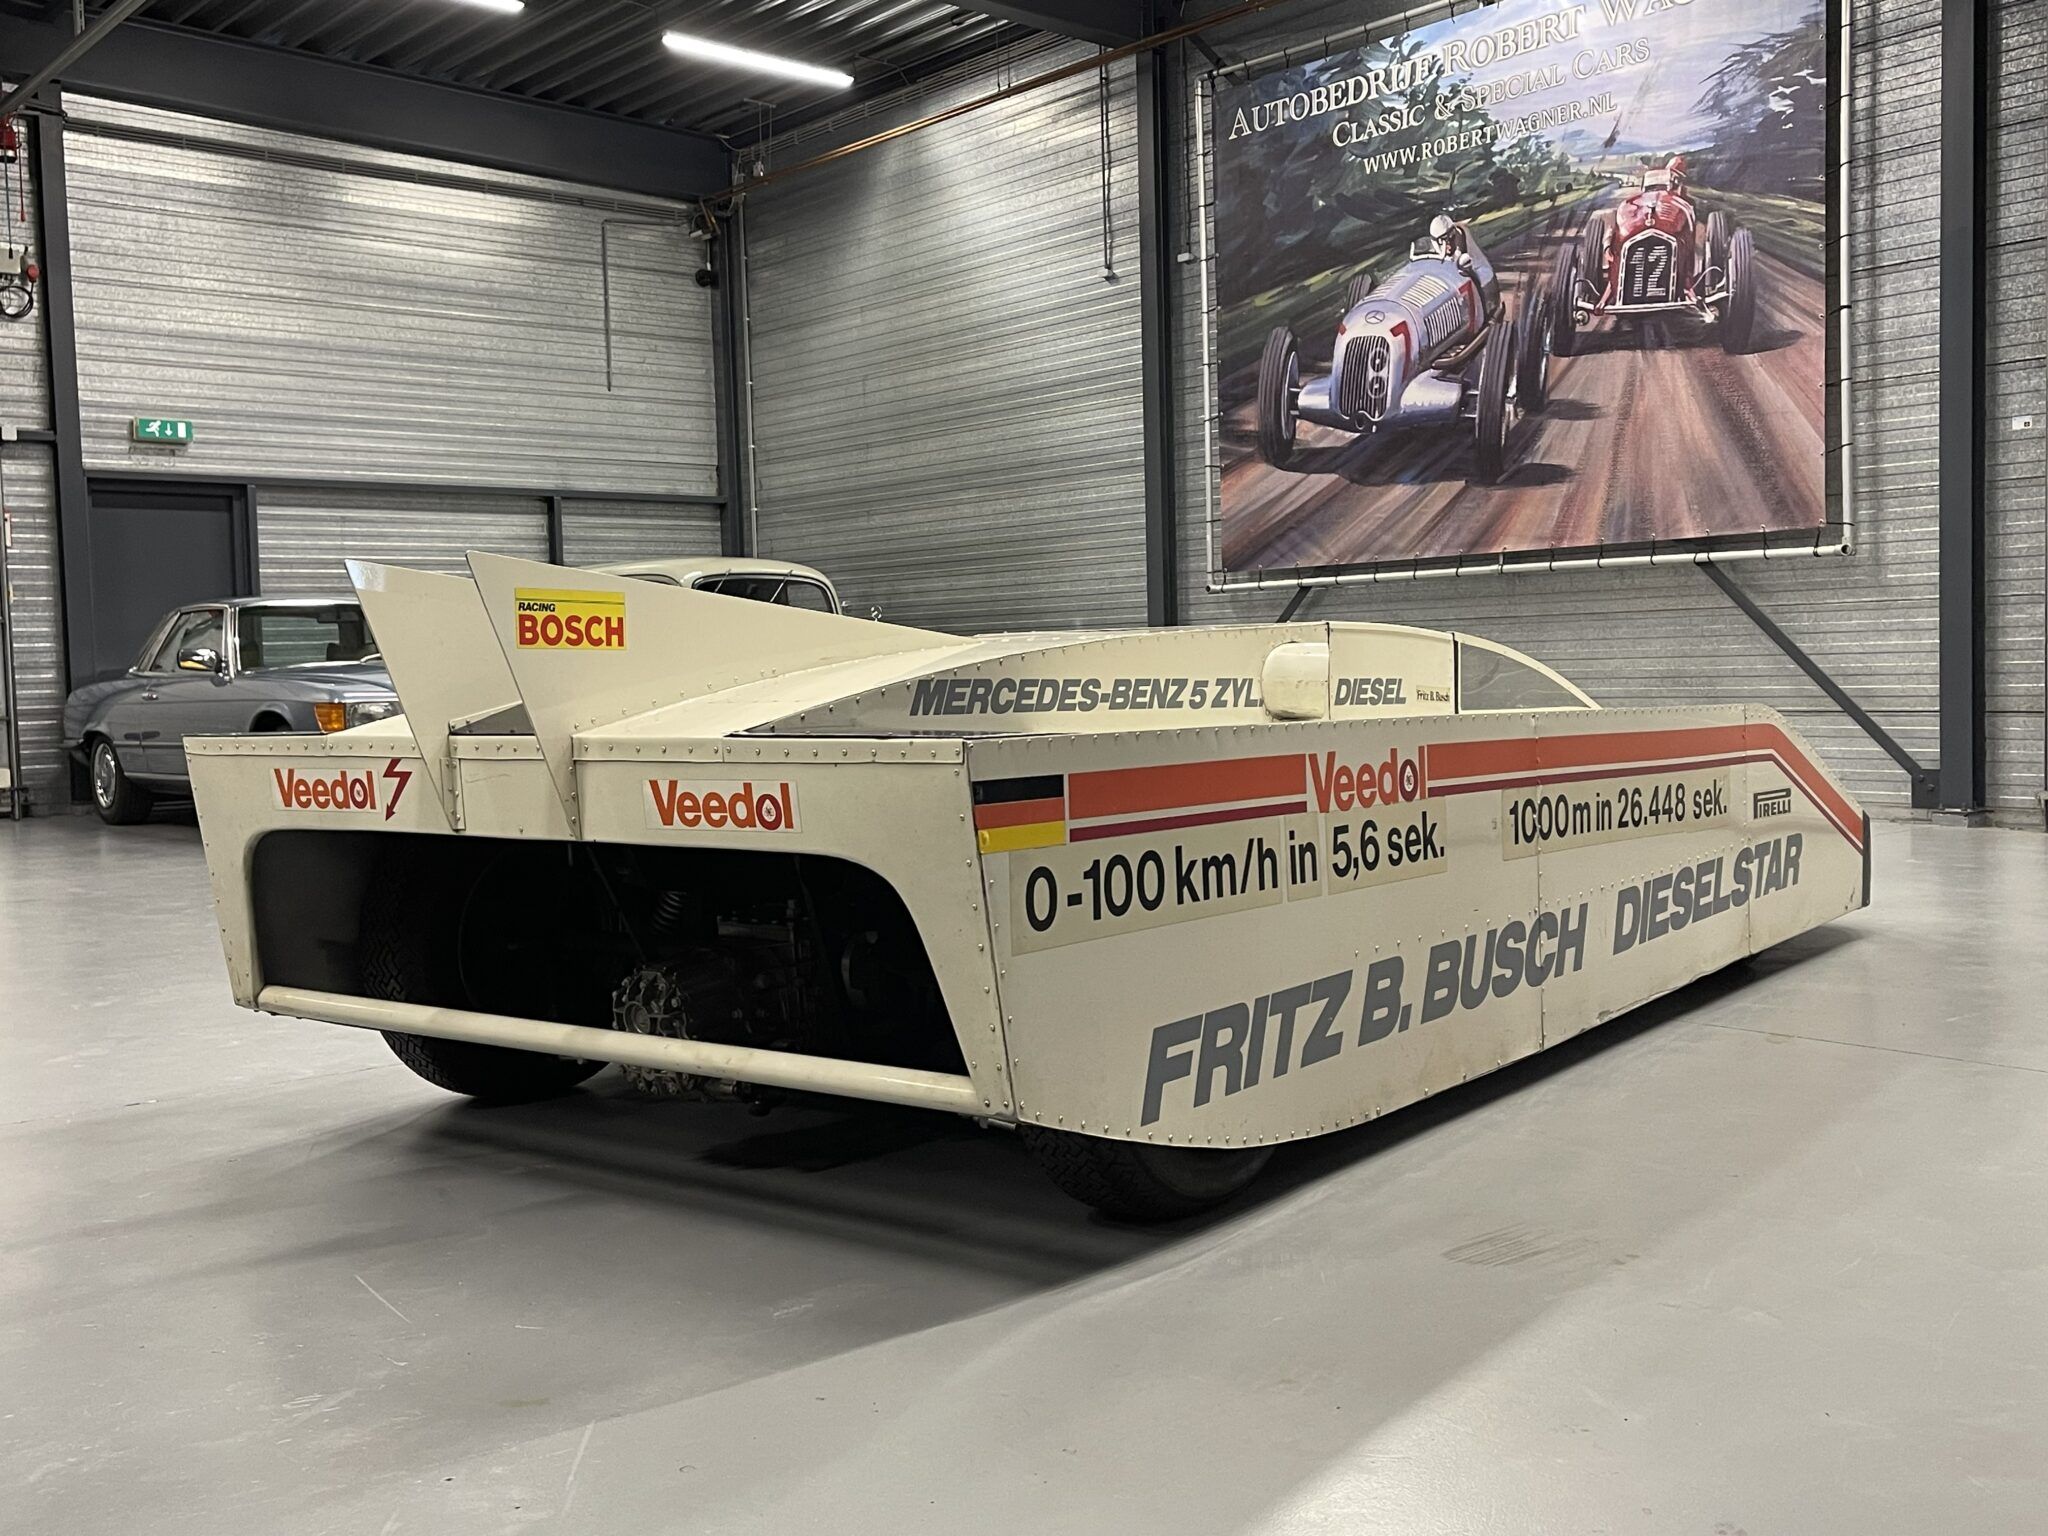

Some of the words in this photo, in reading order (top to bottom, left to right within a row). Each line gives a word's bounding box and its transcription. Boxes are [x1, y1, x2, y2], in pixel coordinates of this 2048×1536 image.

[1228, 54, 1441, 141] AUTOBEDRIJF
[1441, 4, 1587, 78] ROBERT
[1332, 104, 1426, 148] CLASSIC
[1433, 93, 1452, 121] &
[1459, 63, 1566, 113] SPECIAL
[1571, 37, 1650, 80] CARS
[1362, 91, 1618, 175] WWW.ROBERTWAGNER.NL
[518, 602, 556, 612] RACING
[518, 613, 625, 647] BOSCH
[909, 677, 1189, 718] MERCEDES-BENZ
[1188, 679, 1210, 710] 5
[1335, 677, 1407, 706] DIESEL
[273, 767, 378, 812] Veedol
[649, 779, 794, 831] Veedol
[1309, 745, 1427, 813] Veedol
[1596, 792, 1612, 832] in
[1617, 782, 1686, 829] 26.448
[1692, 778, 1728, 820] sek.
[1753, 787, 1792, 820] PIRELLI
[1175, 837, 1278, 907] km/h
[1288, 830, 1318, 892] in
[1331, 819, 1381, 881] 5,6
[1387, 810, 1446, 867] sek.
[1140, 969, 1353, 1127] FRITZ
[1419, 903, 1589, 1025] BUSCH
[1612, 832, 1803, 956] DIESELSTAR
